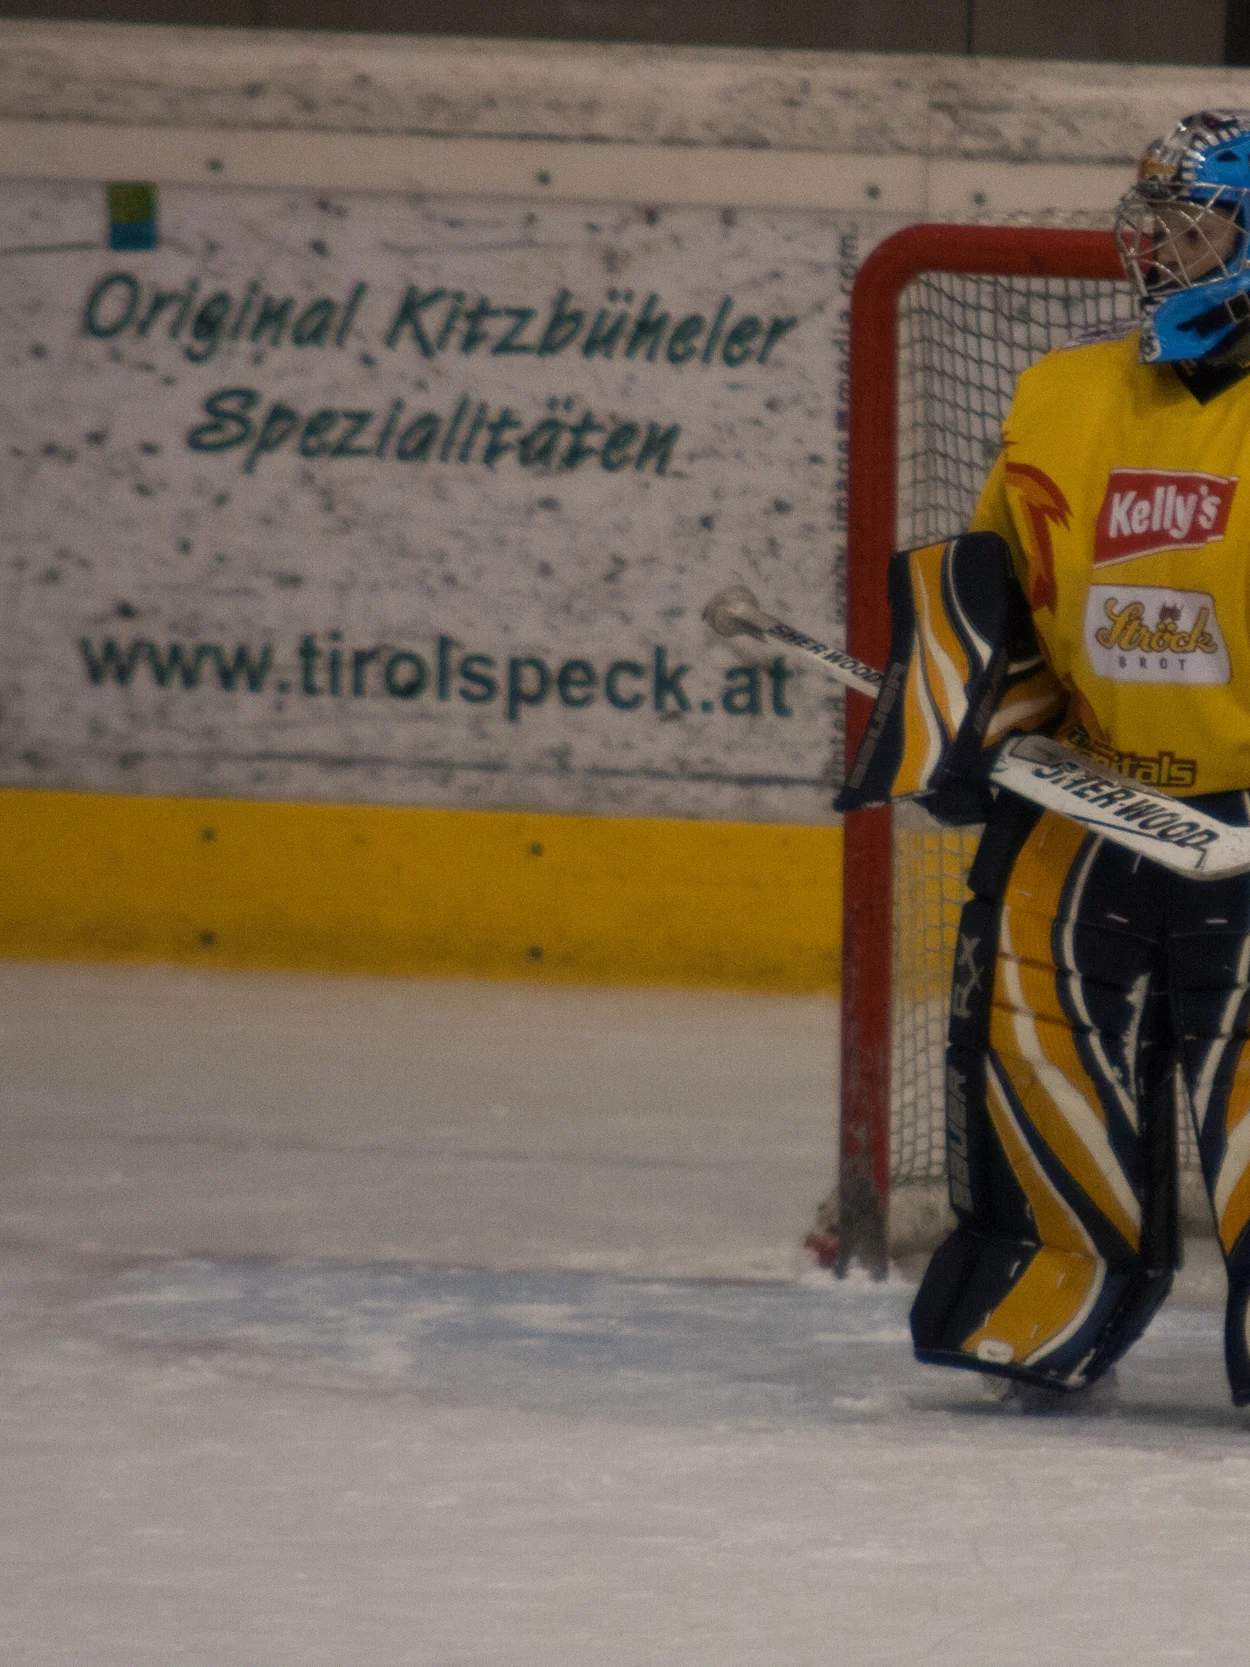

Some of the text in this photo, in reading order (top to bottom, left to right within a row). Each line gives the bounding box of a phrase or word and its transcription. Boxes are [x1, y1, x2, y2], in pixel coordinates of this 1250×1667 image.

[82, 272, 798, 367] Original Kitzbüheler
[189, 387, 681, 475] Spezialitäten
[1107, 484, 1222, 539] Kelly's
[1095, 597, 1219, 653] Ströck
[78, 634, 794, 722] www.tirolspeck.at
[1118, 656, 1187, 670] BROT
